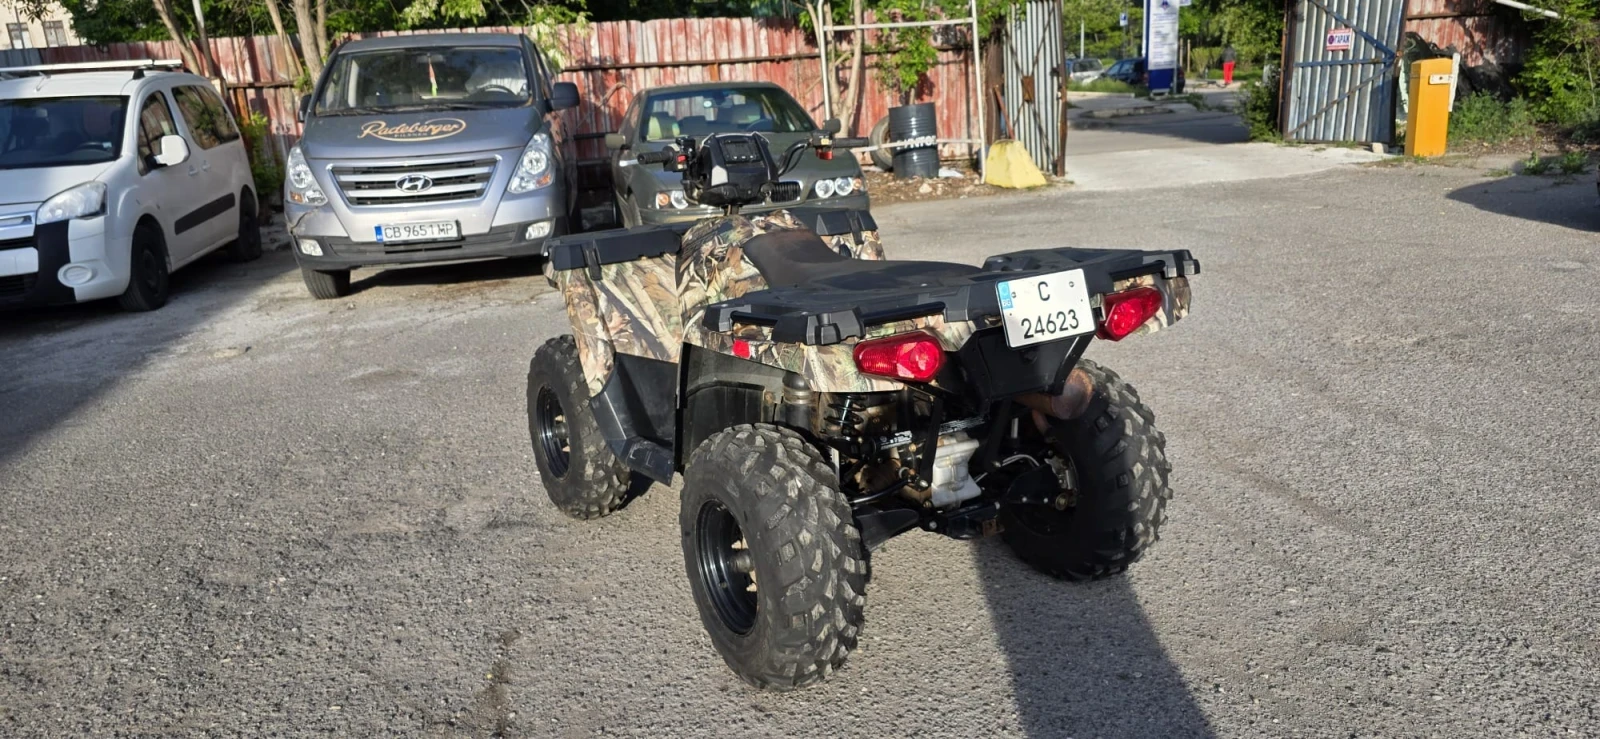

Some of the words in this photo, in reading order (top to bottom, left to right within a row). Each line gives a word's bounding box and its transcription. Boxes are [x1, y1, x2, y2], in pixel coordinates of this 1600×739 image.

[357, 118, 465, 140] Radeberger
[384, 226, 402, 239] CB
[403, 224, 435, 237] 9651
[1037, 281, 1051, 302] C
[1020, 308, 1080, 340] 24623
